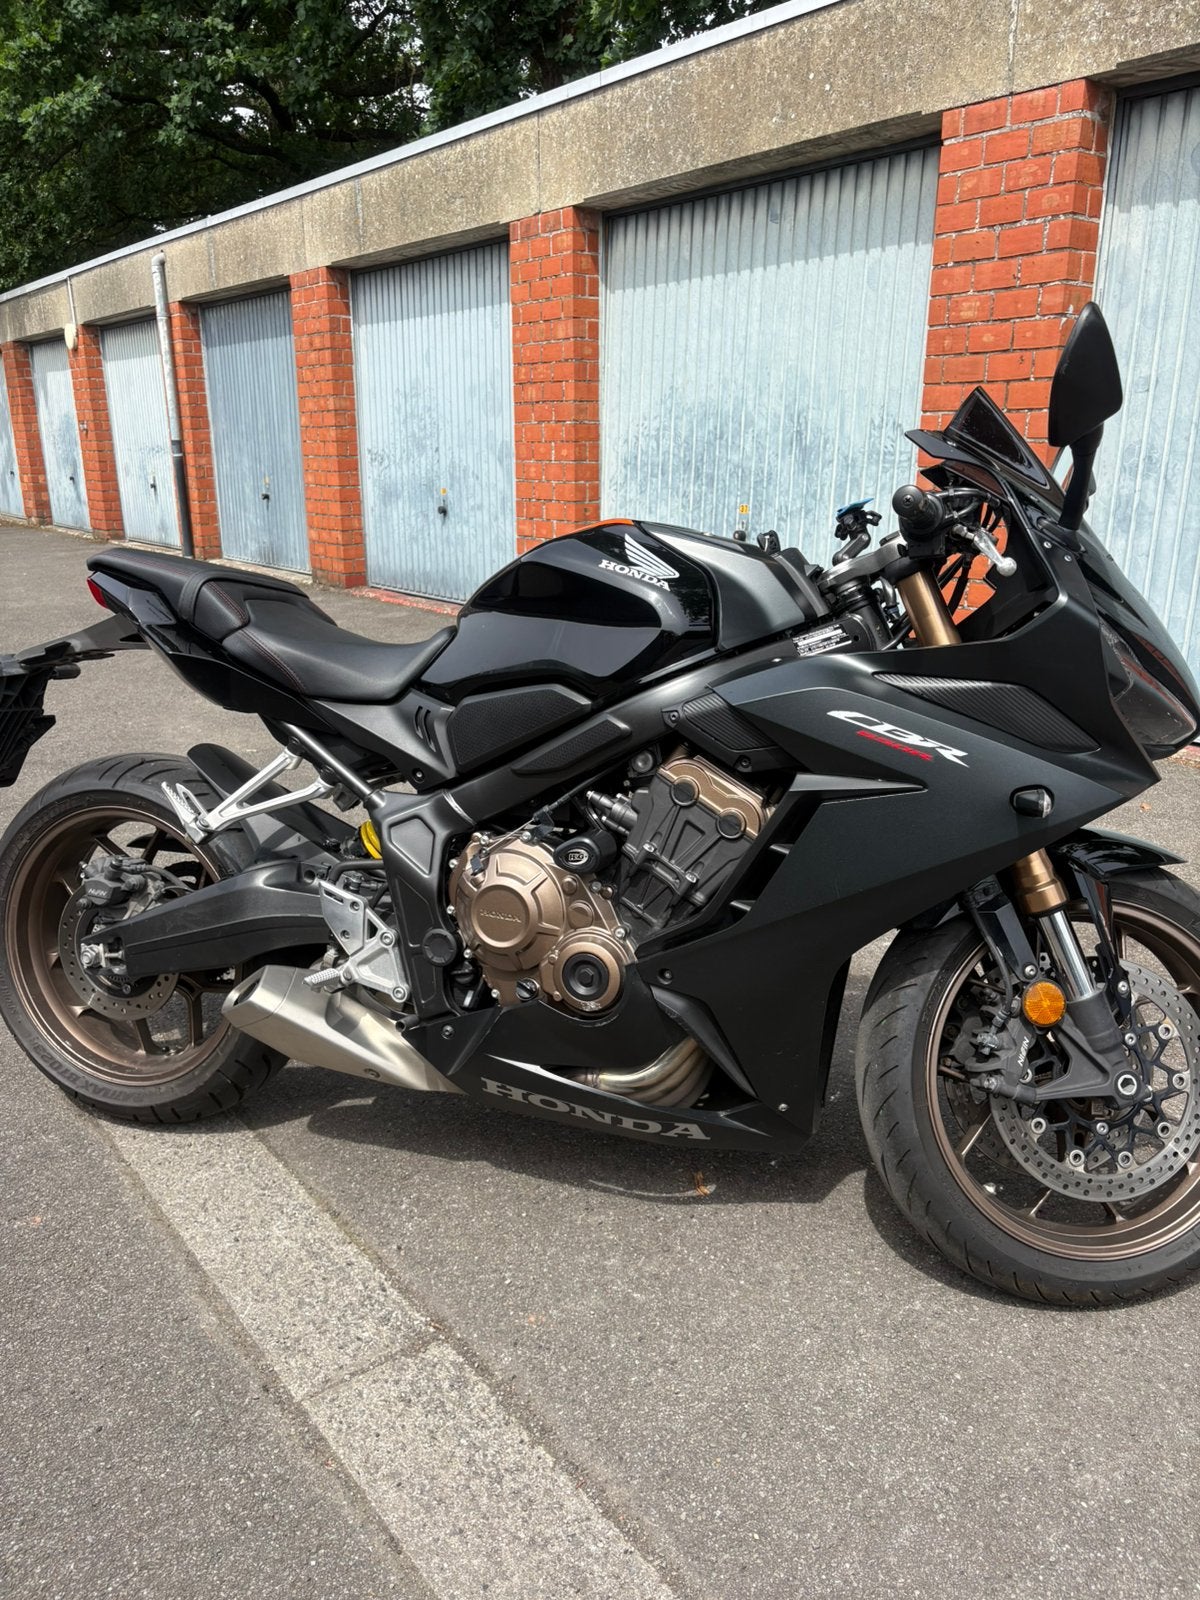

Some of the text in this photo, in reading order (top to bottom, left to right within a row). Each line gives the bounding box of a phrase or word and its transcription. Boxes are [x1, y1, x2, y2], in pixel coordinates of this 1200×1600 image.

[598, 559, 671, 592] HONDA
[826, 710, 970, 768] CBR
[480, 909, 522, 923] HONDA
[481, 1077, 711, 1141] HONDA
